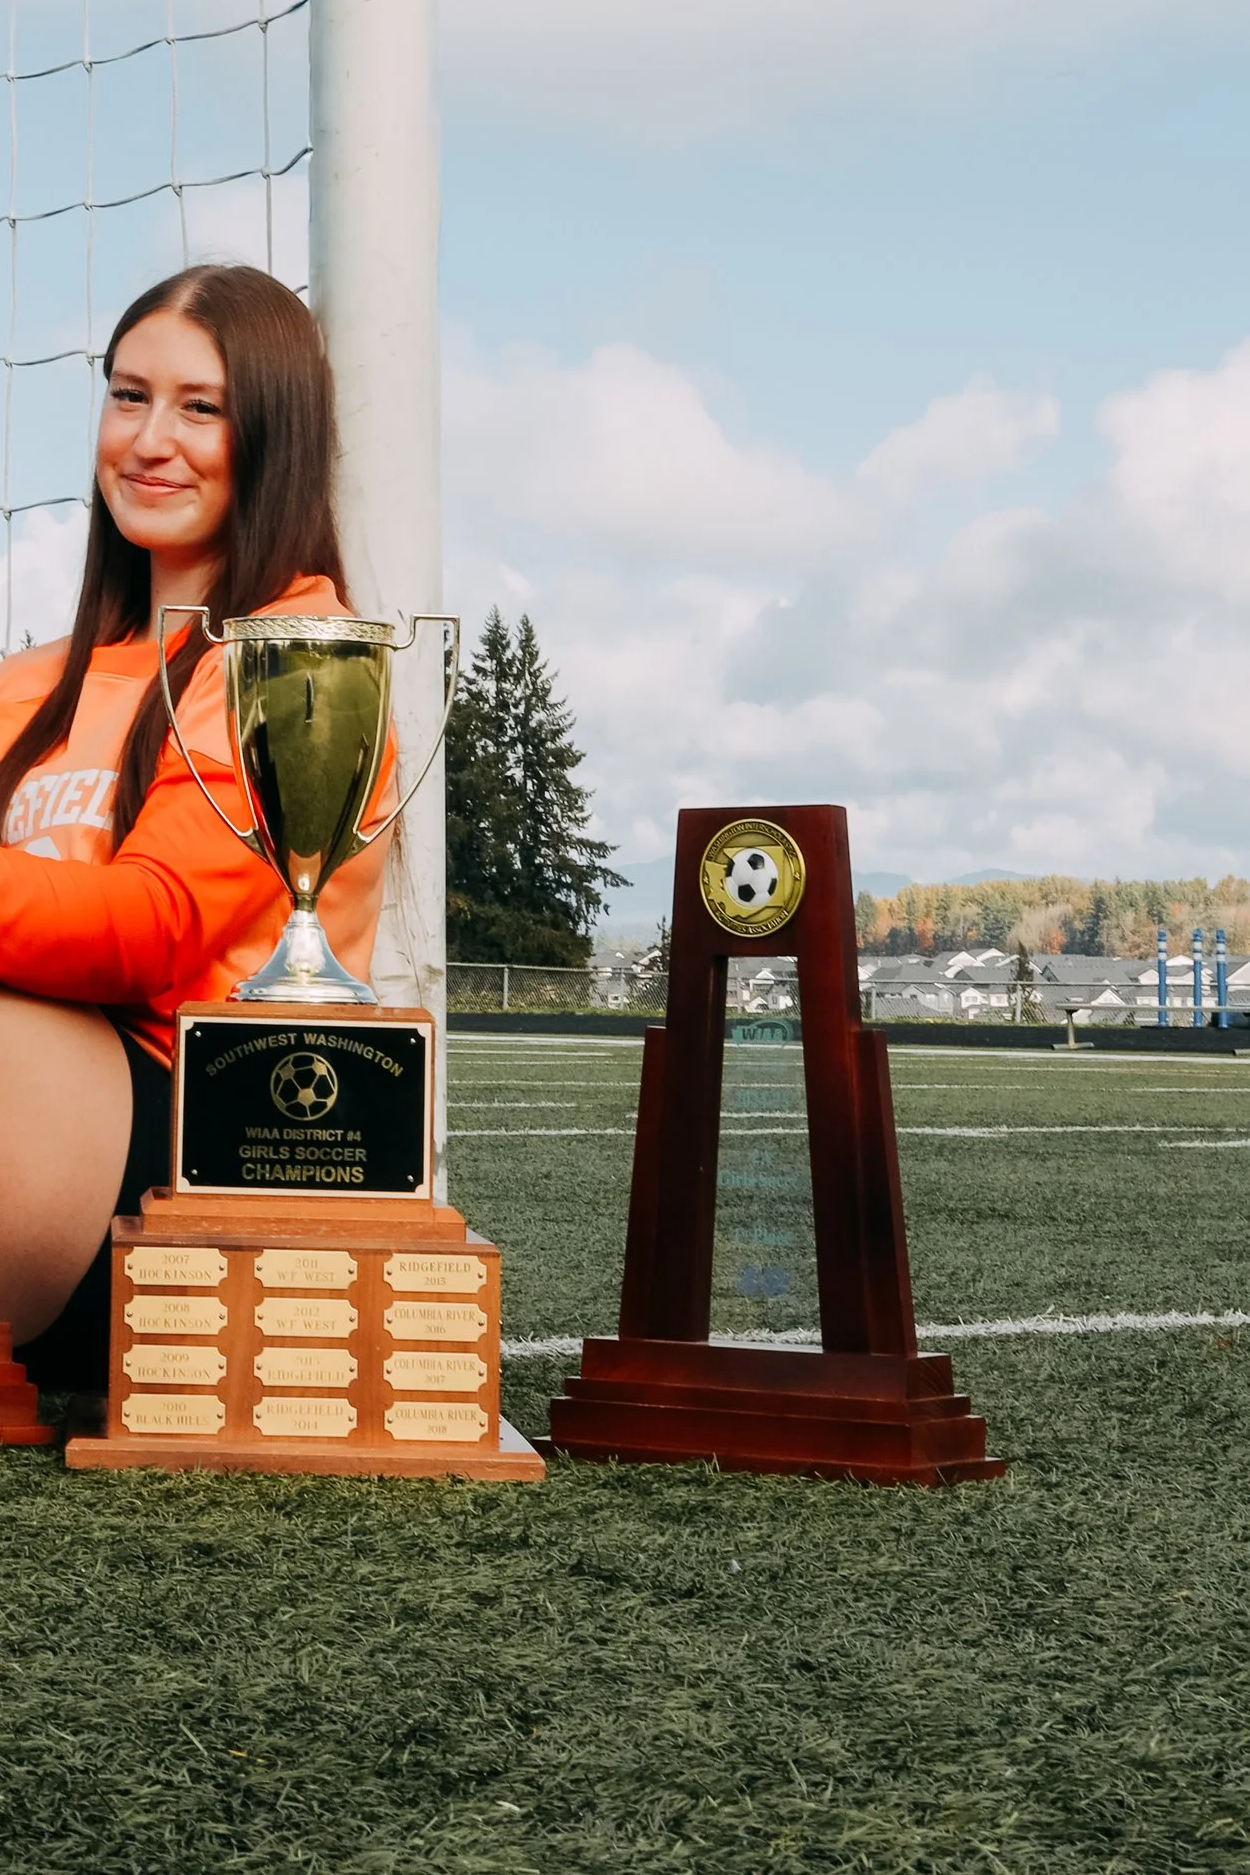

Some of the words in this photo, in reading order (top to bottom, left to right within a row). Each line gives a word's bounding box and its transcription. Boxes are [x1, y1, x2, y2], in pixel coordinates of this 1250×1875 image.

[205, 1033, 297, 1076] SOUTHWEST
[303, 1033, 404, 1077] WASHINGTON
[245, 1127, 280, 1140] WIAA
[283, 1128, 344, 1141] DISTRICT
[347, 1130, 362, 1141] #4
[239, 1144, 290, 1159] GIRLS
[295, 1146, 368, 1162] SOCCER
[241, 1163, 364, 1183] CHAMPIONS
[161, 1254, 190, 1265] 2007
[399, 1261, 471, 1273] RIDGEFIELD
[139, 1268, 212, 1280] HOCKINSON
[304, 1272, 335, 1282] WEST
[161, 1302, 190, 1313] 2008
[394, 1308, 442, 1321] COLUMBIA
[446, 1310, 476, 1322] RIVER
[138, 1316, 212, 1329] HOCKINSON
[303, 1320, 336, 1331] WEST
[161, 1352, 190, 1363] 2009
[394, 1358, 442, 1370] COLUMBIA
[446, 1360, 476, 1371] RIVER
[137, 1366, 211, 1378] HOCKINSON
[267, 1369, 345, 1381] RIDGEFIELD
[266, 1404, 344, 1416] RIDGEFIELD
[395, 1408, 444, 1421] COLUMBIA
[447, 1410, 477, 1422] RIVER
[136, 1414, 176, 1425] BLACK
